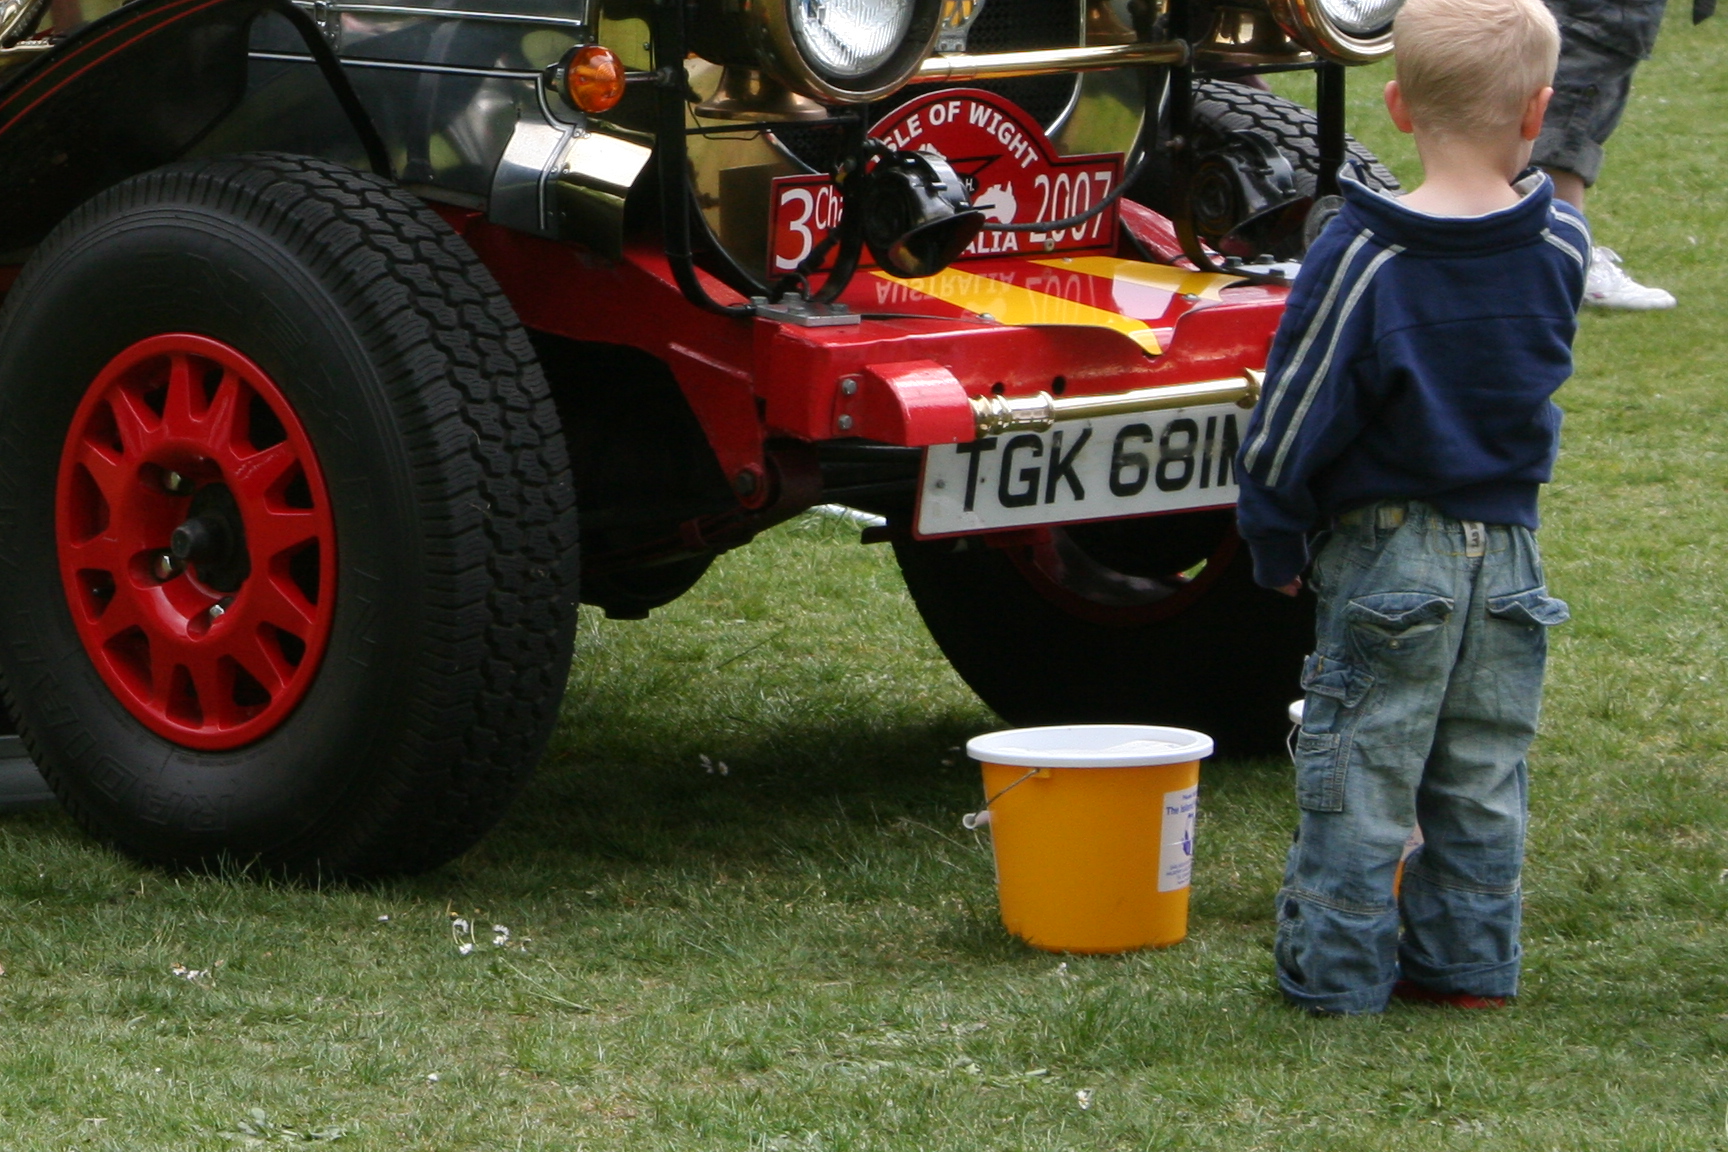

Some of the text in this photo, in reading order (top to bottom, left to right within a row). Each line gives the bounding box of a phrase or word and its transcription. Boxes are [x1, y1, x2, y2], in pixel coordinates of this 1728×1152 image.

[878, 100, 1039, 170] SLE OF WIGHT
[1029, 171, 1112, 244] 2007
[956, 427, 1093, 513] TGK
